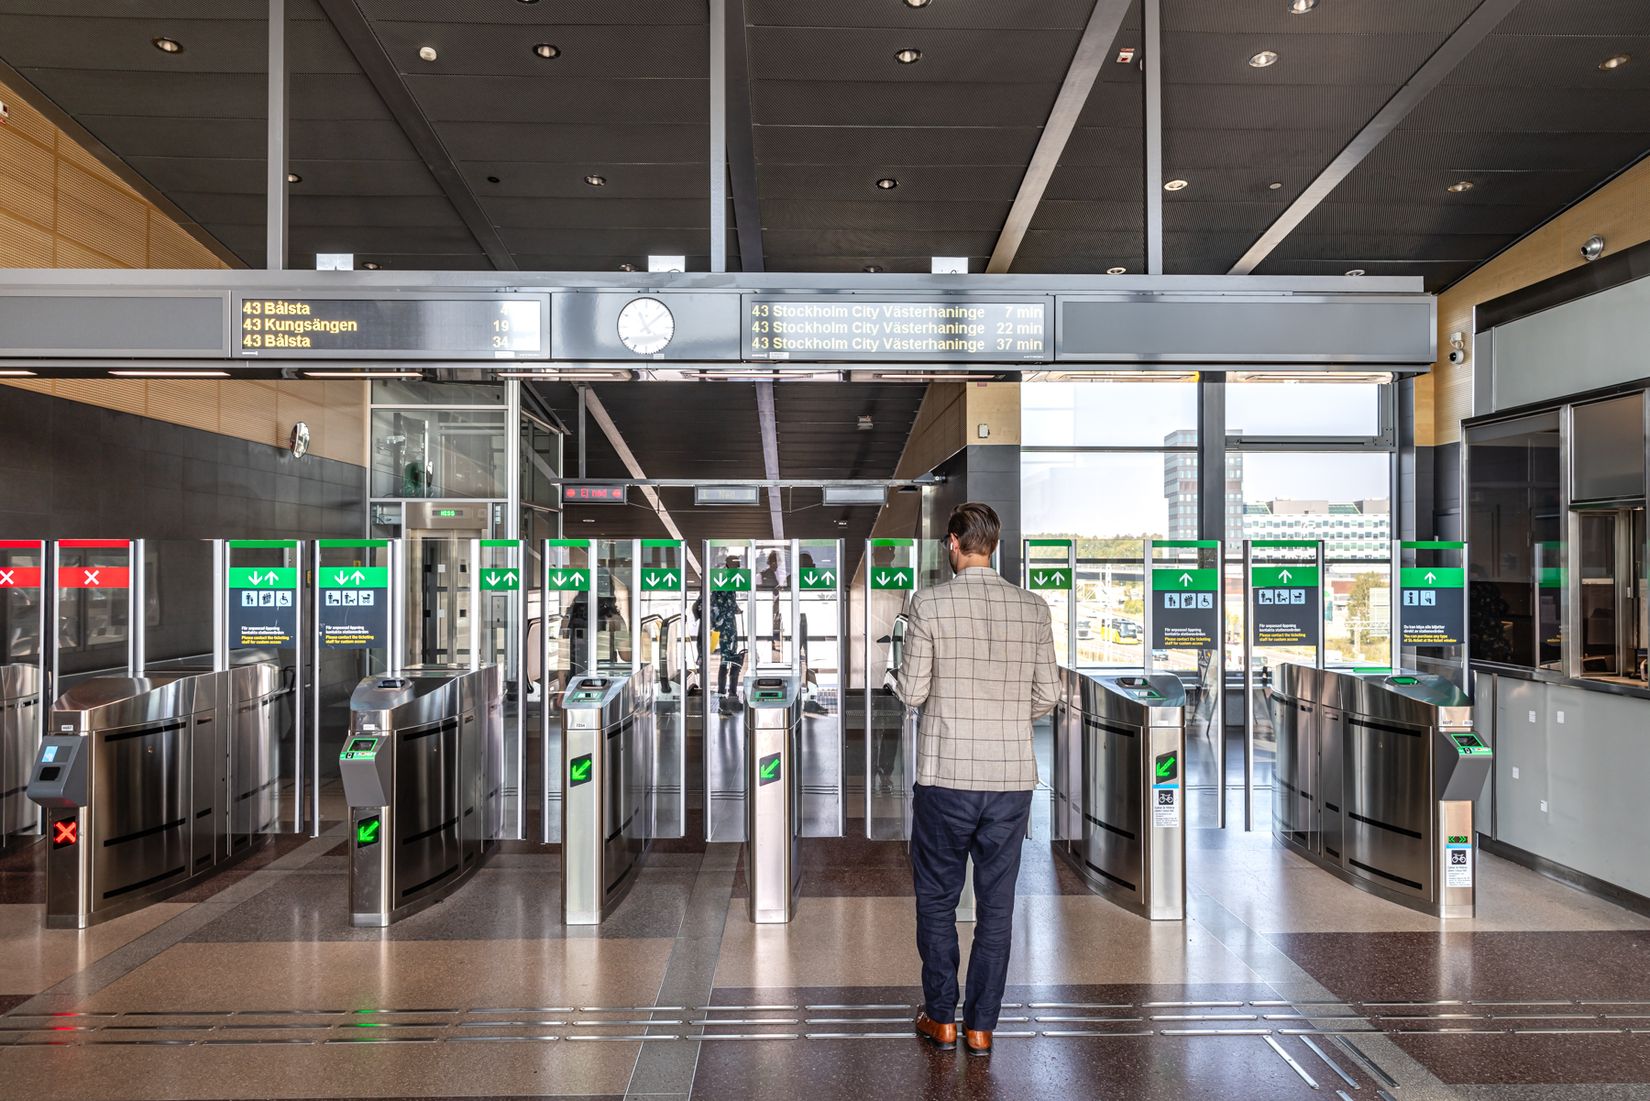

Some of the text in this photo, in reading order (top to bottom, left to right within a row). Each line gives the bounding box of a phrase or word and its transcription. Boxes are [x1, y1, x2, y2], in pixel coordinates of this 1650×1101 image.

[243, 302, 261, 314] 43
[264, 301, 310, 314] Bålsta
[752, 305, 1042, 320] 43 Stockholm City Västerhaninge 7 min
[243, 318, 509, 334] 43 Kungsängen 19
[752, 321, 1042, 336] 43 Stockholm City Västerhaninge 22 min
[243, 334, 508, 348] 43 Bålsta 34
[752, 337, 1042, 352] 43 Stockholm City Västerhaninge 37 min
